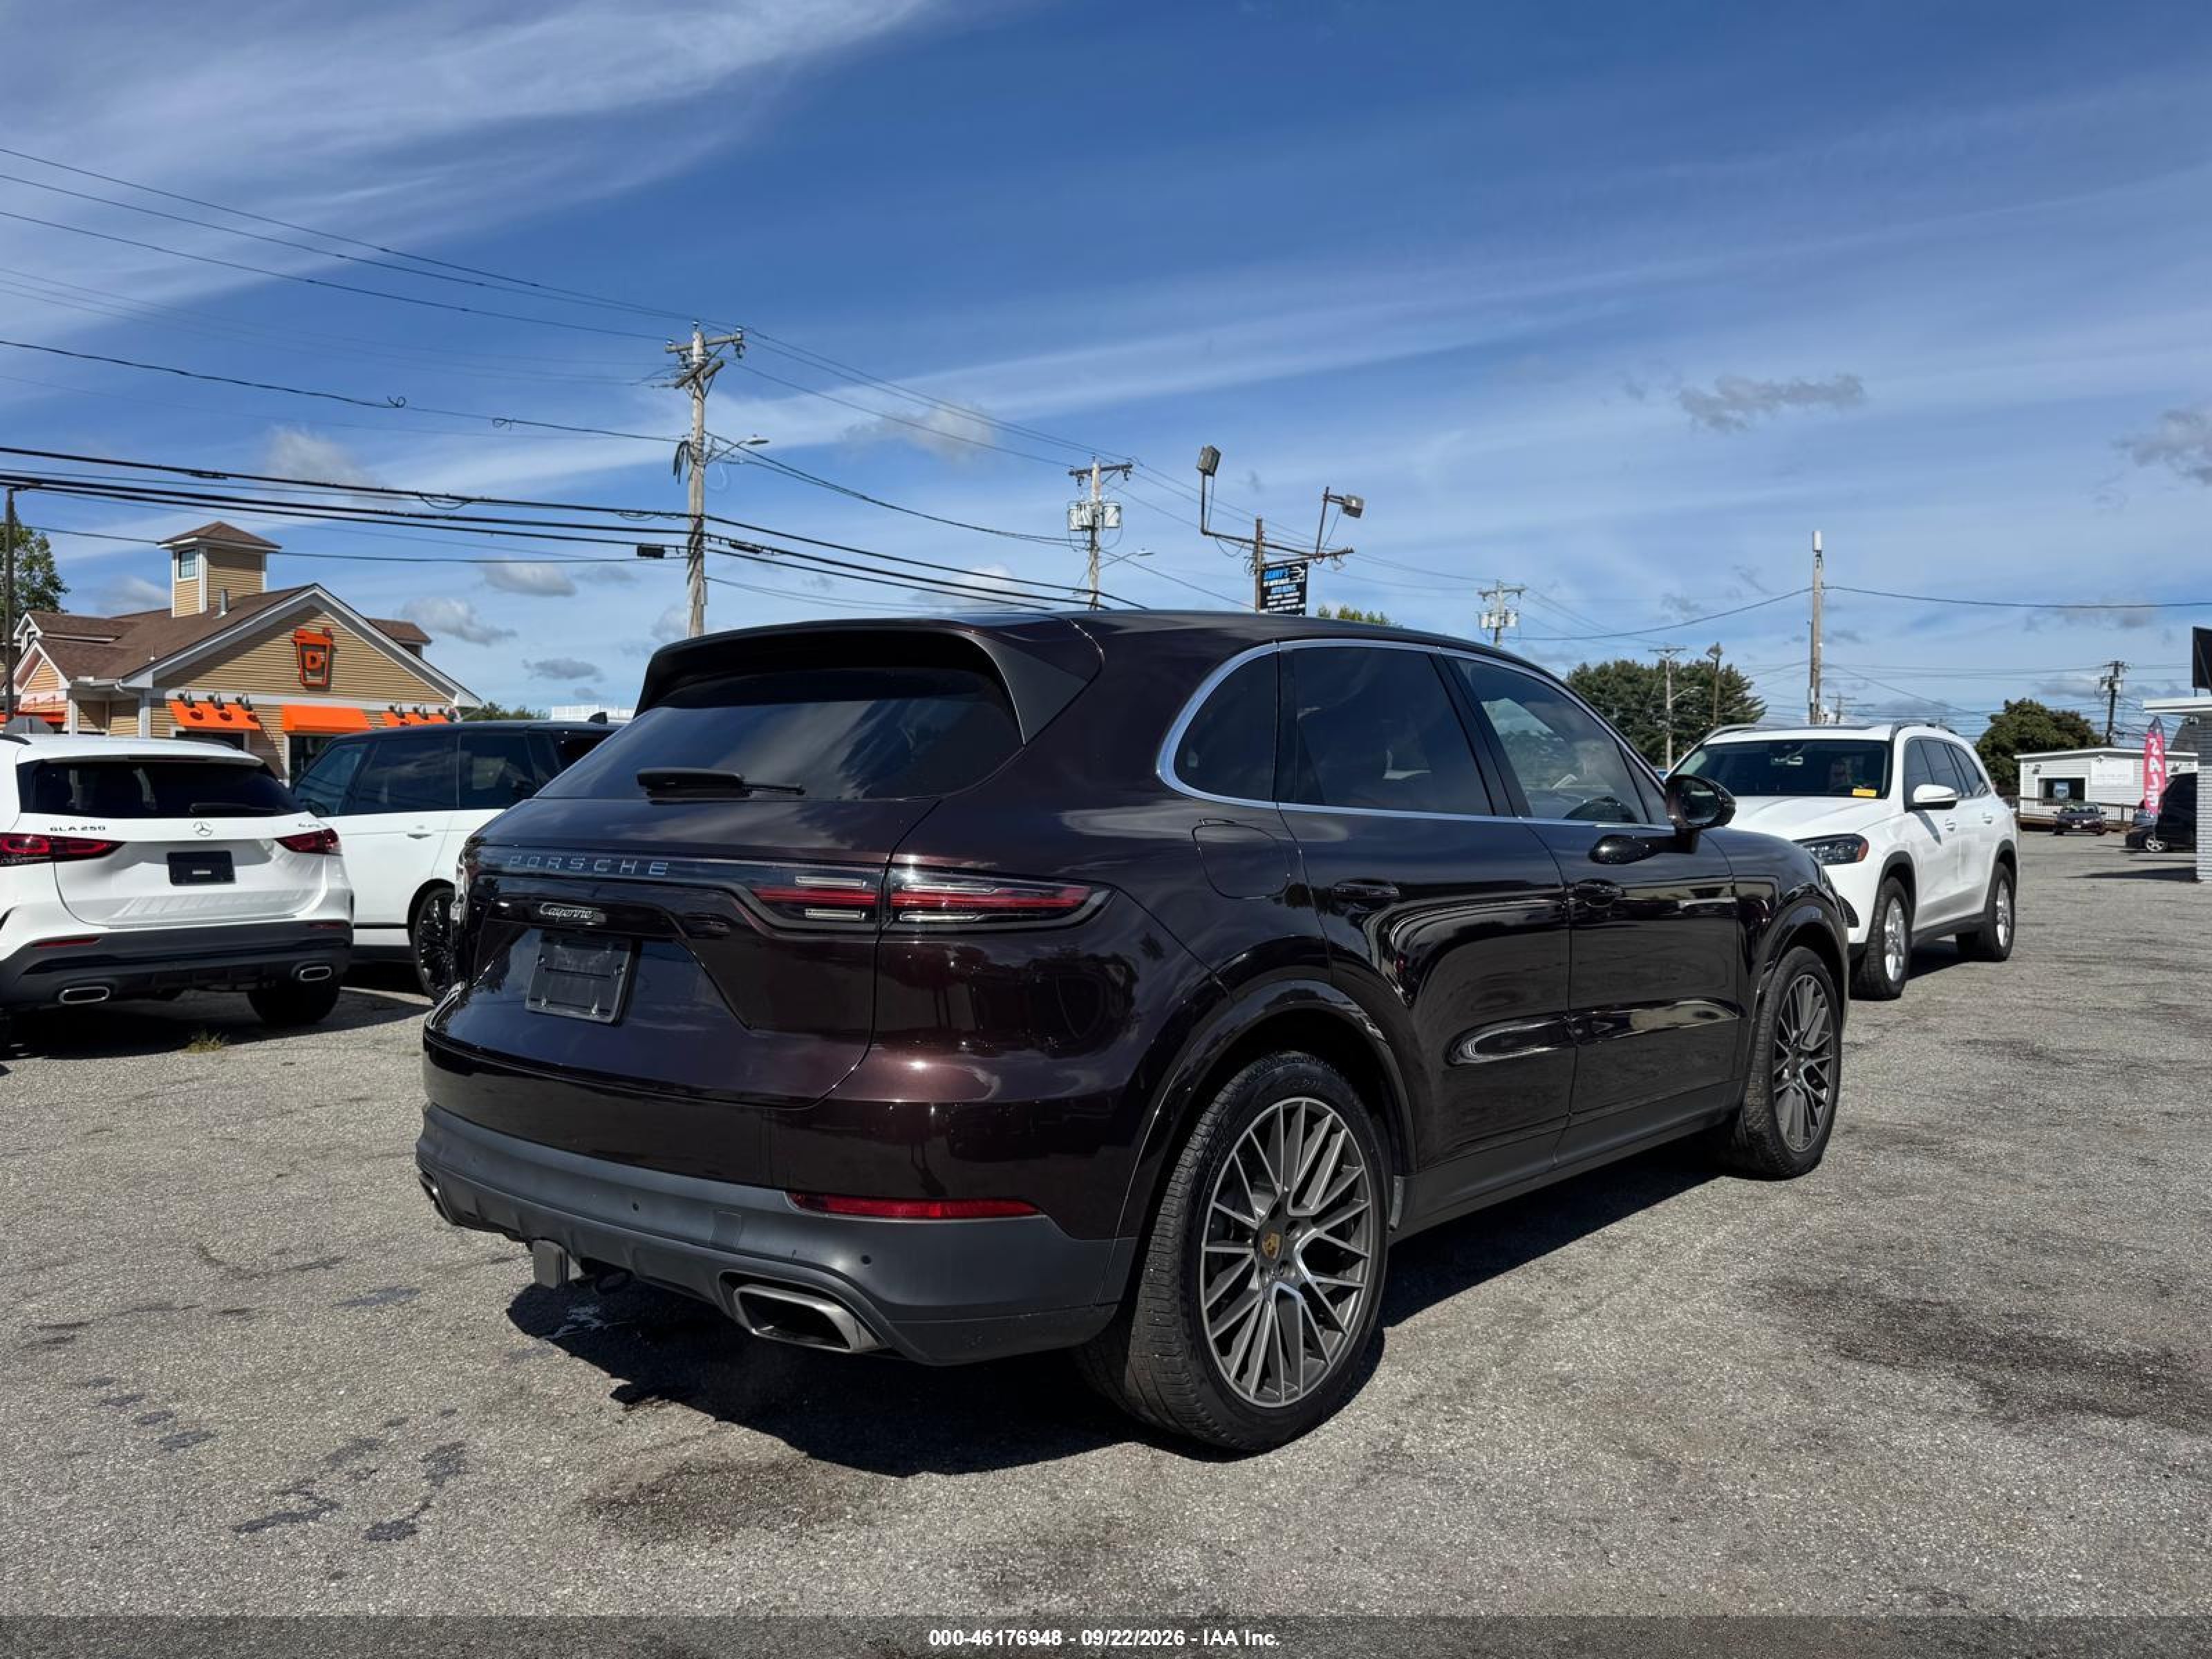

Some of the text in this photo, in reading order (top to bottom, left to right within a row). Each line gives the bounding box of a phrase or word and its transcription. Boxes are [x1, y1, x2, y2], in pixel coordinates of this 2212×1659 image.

[306, 651, 321, 669] D
[509, 855, 668, 876] PORSCHE
[540, 903, 600, 923] Cayenne
